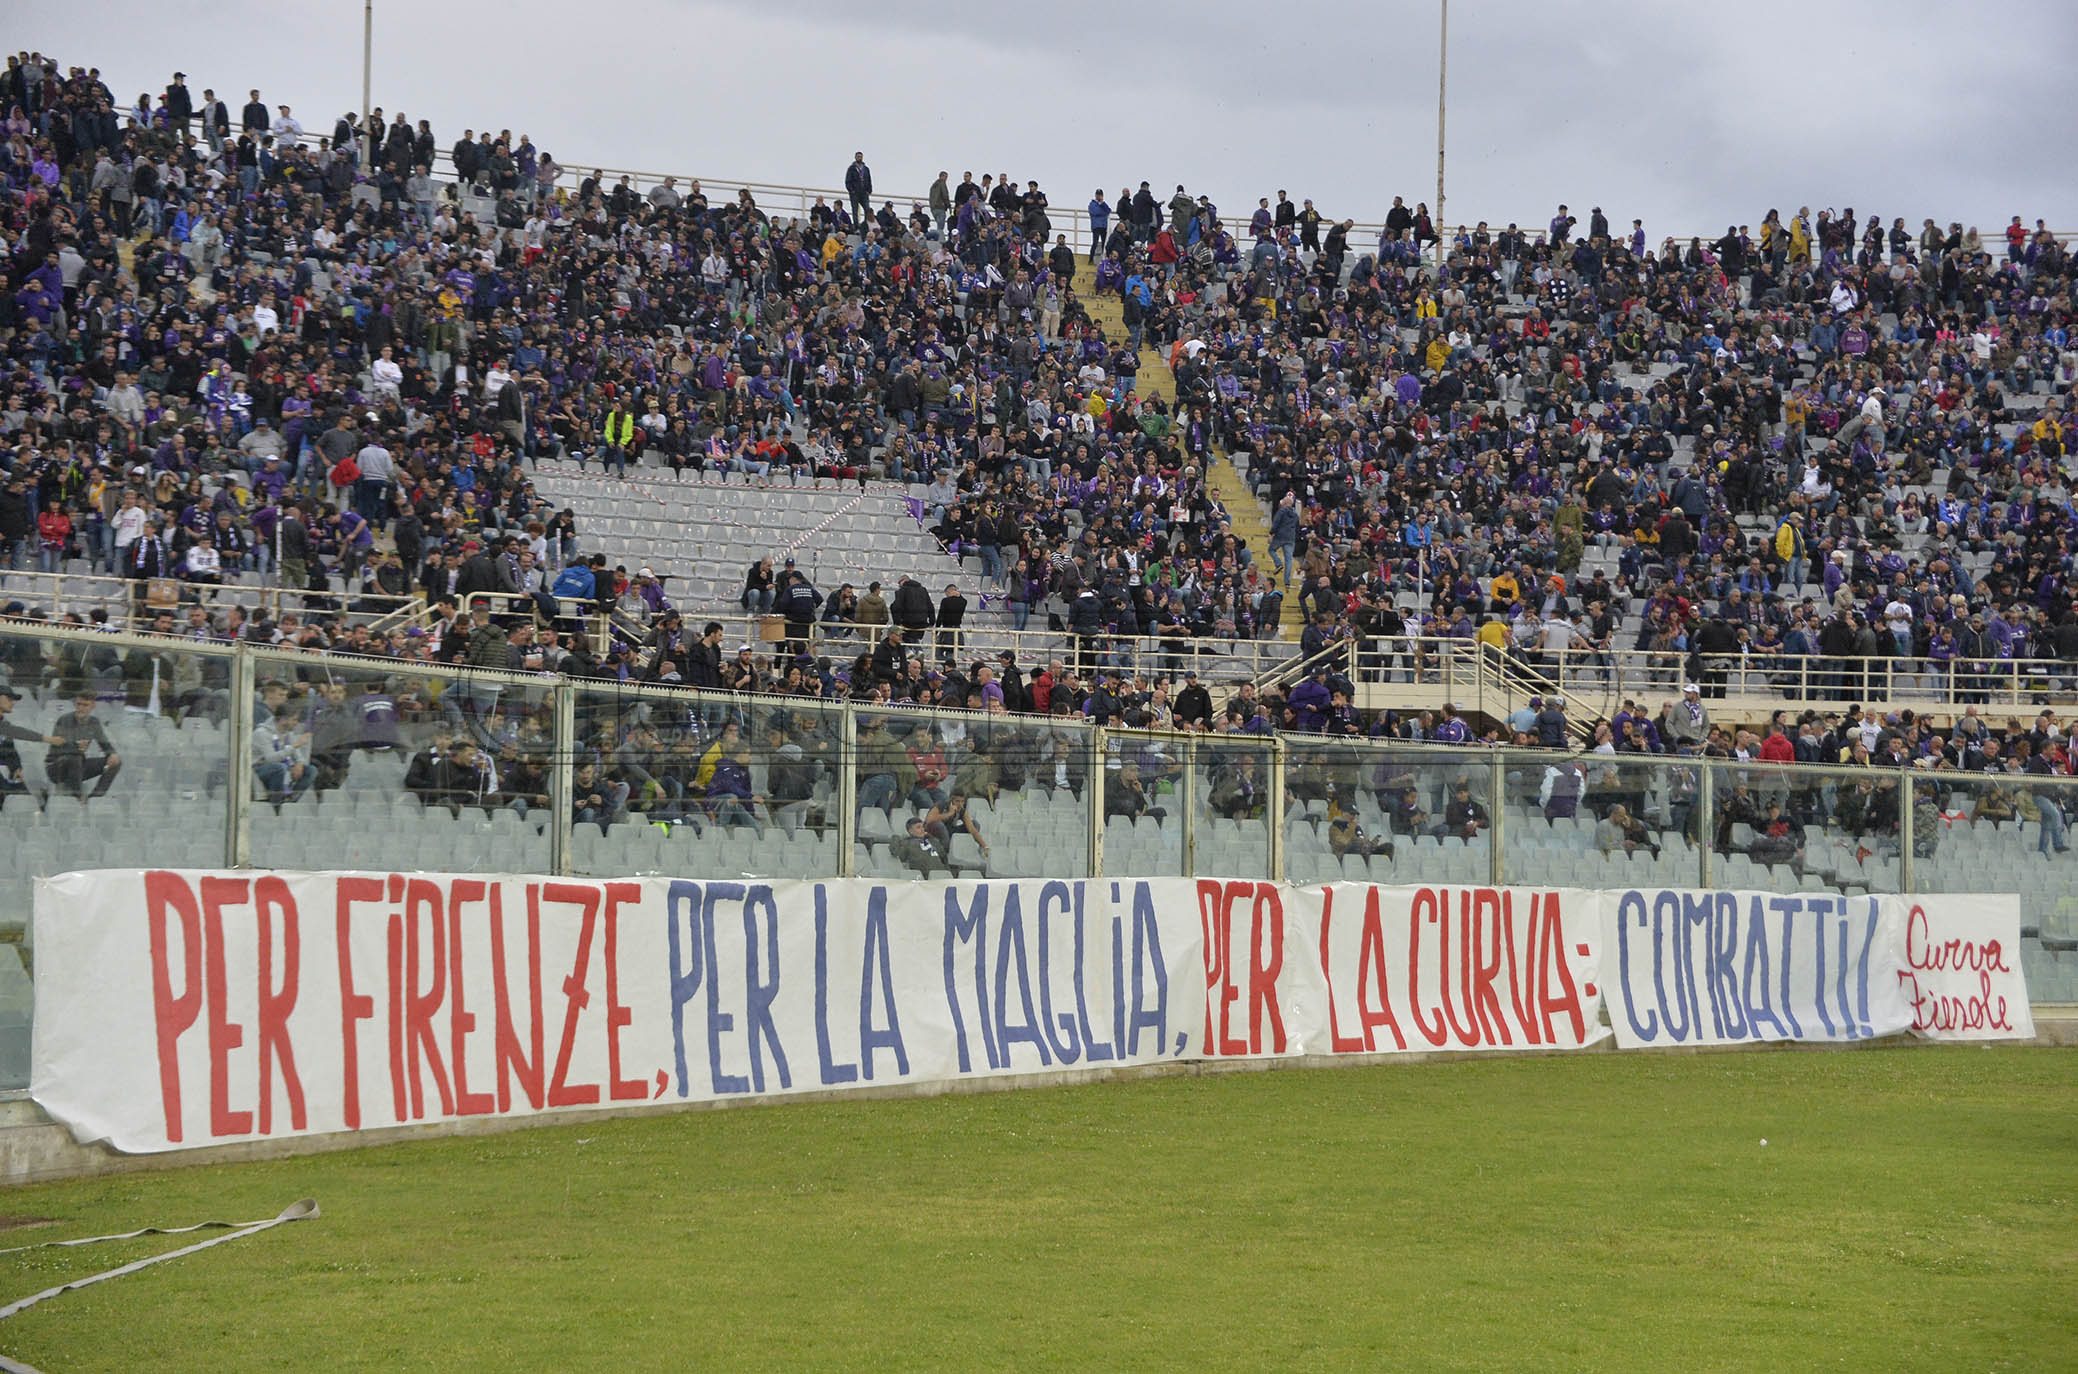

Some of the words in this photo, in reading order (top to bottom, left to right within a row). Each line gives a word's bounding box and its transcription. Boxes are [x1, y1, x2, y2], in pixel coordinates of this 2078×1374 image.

[1906, 904, 2010, 973] Curva
[144, 870, 307, 1143] PER
[668, 880, 792, 1097] PER
[814, 883, 910, 1085] LA
[1196, 879, 1287, 1056] PER
[1319, 885, 1407, 1053] LA
[1409, 887, 1597, 1048] CURVA:
[1897, 968, 2013, 1032] Fiesole
